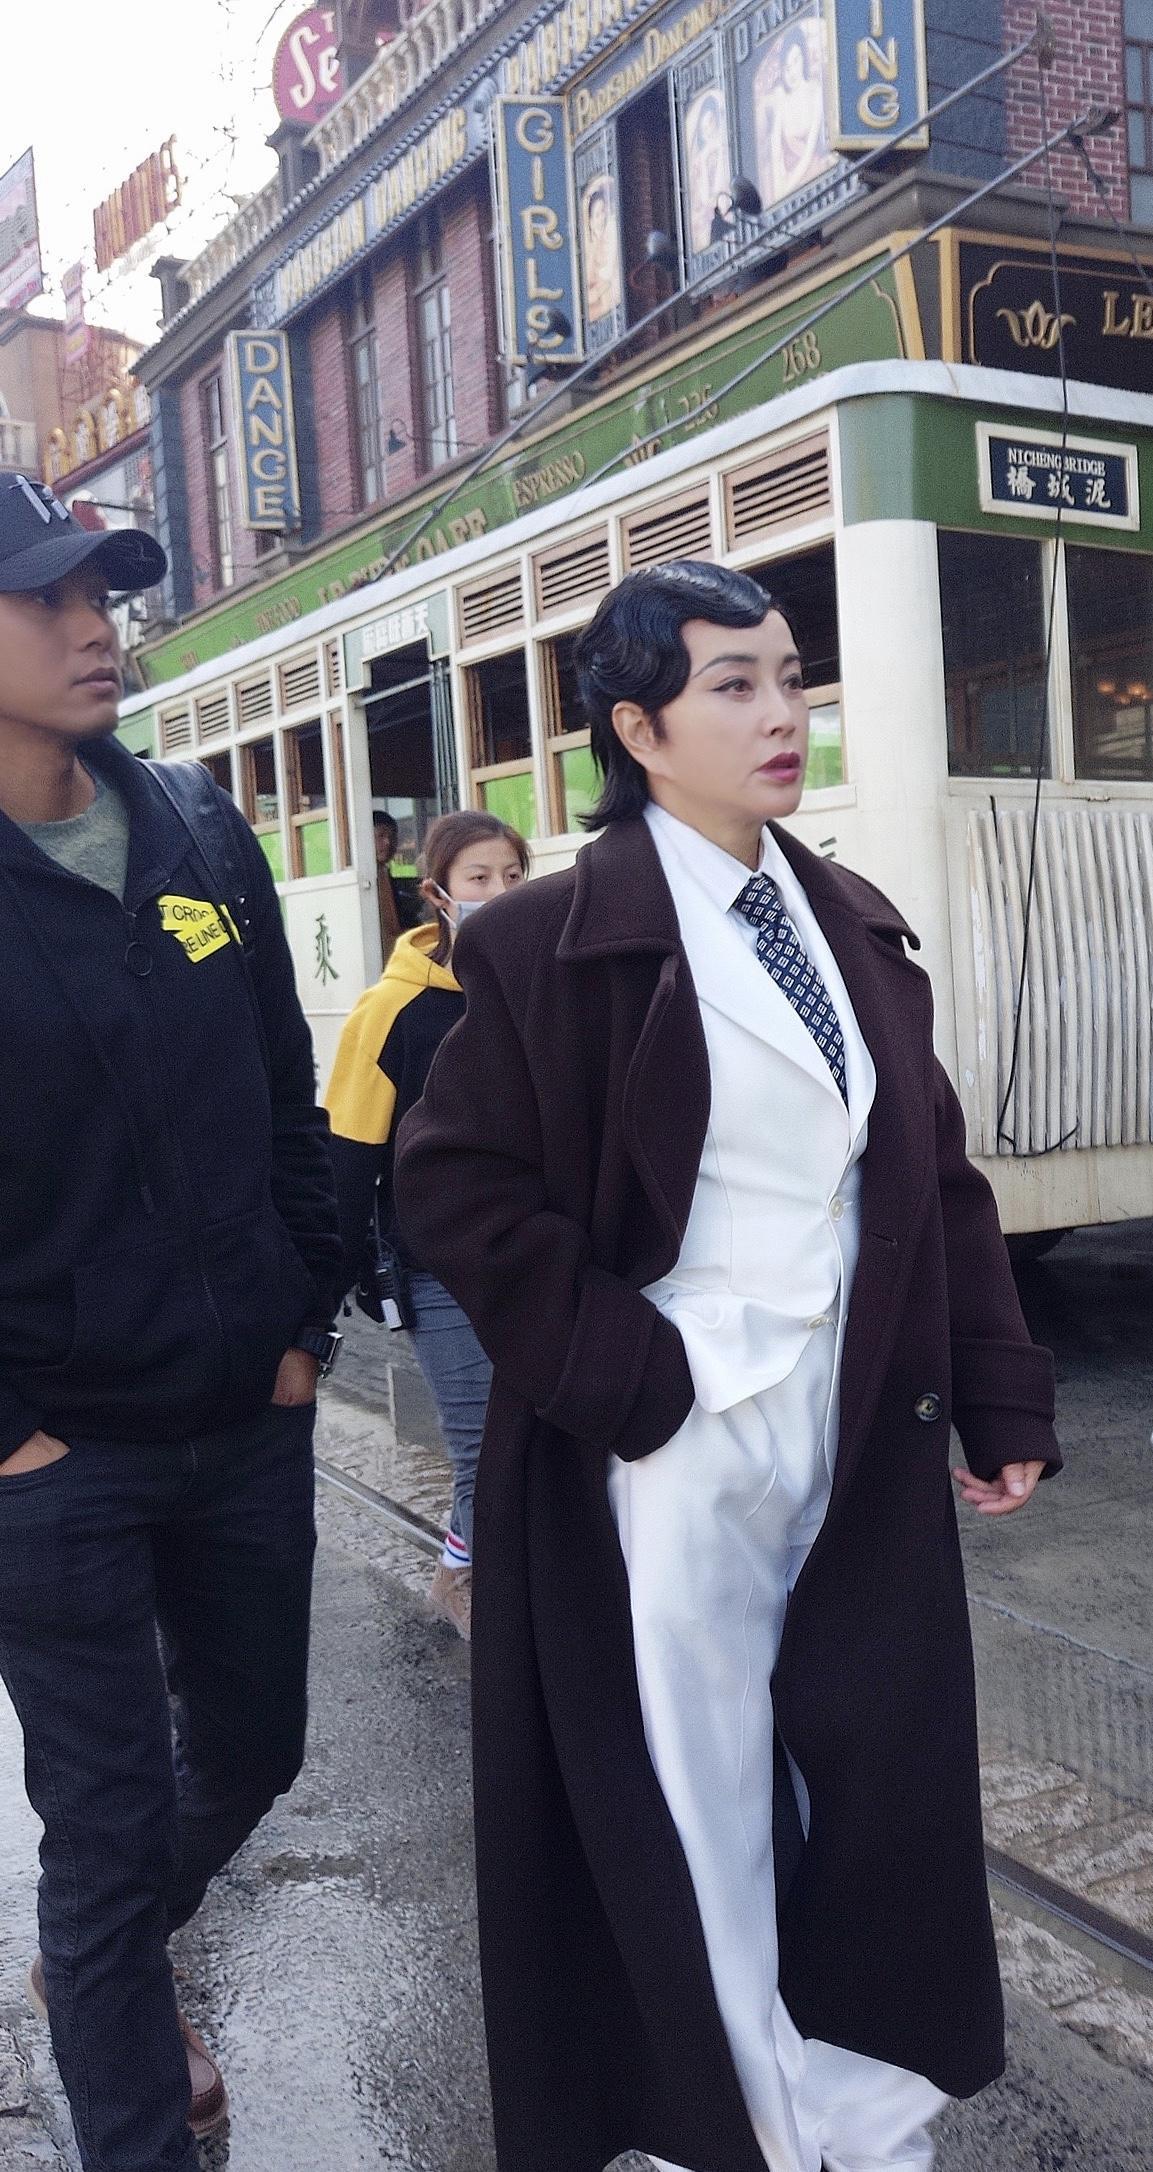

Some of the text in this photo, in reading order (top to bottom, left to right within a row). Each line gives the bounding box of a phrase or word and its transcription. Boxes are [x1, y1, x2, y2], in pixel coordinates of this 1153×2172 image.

[516, 107, 564, 349] GIRLS
[1008, 447, 1106, 477] NICHENG BRIDGE
